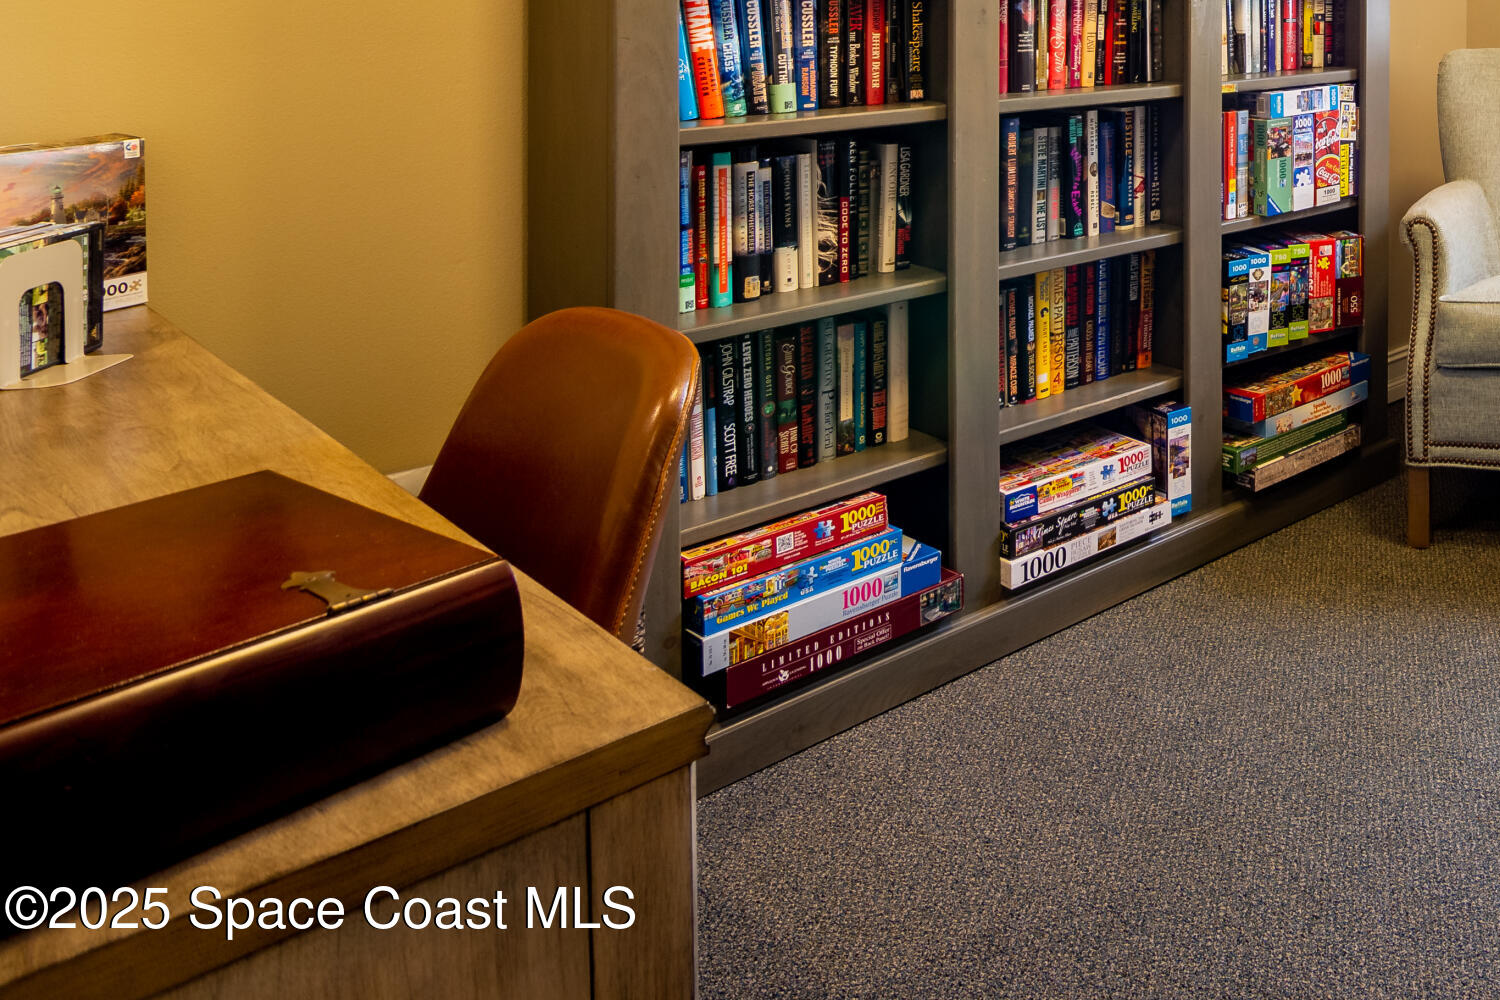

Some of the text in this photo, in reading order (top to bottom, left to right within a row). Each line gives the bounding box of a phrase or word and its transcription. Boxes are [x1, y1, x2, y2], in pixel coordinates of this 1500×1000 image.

[720, 0, 733, 41] CUSSLER
[747, 0, 757, 48] CUSSLER
[802, 0, 813, 48] CUSSLER
[908, 1, 922, 72] Shakespeare
[722, 43, 734, 72] CHASE
[849, 44, 860, 66] Broken
[871, 32, 881, 88] JEFFERY DEAVER
[750, 62, 767, 104] PIRATE
[801, 67, 809, 96] RANSOM
[829, 46, 838, 97] TYPHOON FURY
[849, 68, 859, 94] Window
[1125, 111, 1133, 156] JUSTICE
[1295, 118, 1312, 128] 1000
[900, 147, 911, 196] LISA GARDNER
[1037, 136, 1046, 188] STEVE MARTINI
[888, 162, 896, 202] ENCORE
[1036, 202, 1045, 231] THE LIST
[841, 201, 849, 274] CODE TO ZERO
[1232, 264, 1246, 272] 1000
[1251, 257, 1266, 265] 1000
[1054, 270, 1064, 370] JAMES PATTERSON
[742, 342, 751, 367] LEVEL
[1066, 337, 1079, 378] PATTERSON
[720, 344, 734, 406] JOHN GILSTRAP
[743, 368, 752, 388] ZERO
[1321, 369, 1342, 388] 1000
[744, 390, 753, 422] HEROES
[1171, 414, 1188, 424] 1000
[724, 424, 737, 477] SCOTT FREE
[1118, 451, 1143, 473] 1000
[1125, 460, 1149, 472] PUZZLE
[1127, 495, 1153, 510] PUZZLE
[840, 504, 876, 533] 1000
[851, 514, 884, 531] PUZZLE
[863, 550, 898, 569] PUZZLE
[903, 556, 939, 573] Ravensburger
[1021, 547, 1067, 584] 1000
[690, 564, 748, 592] BACON 101
[716, 592, 788, 624] Games We Played
[842, 577, 882, 610] 1000
[842, 590, 900, 617] Ravensburger Puzzle
[761, 612, 890, 673] LIMITED EDITIONS
[810, 645, 842, 672] 1000
